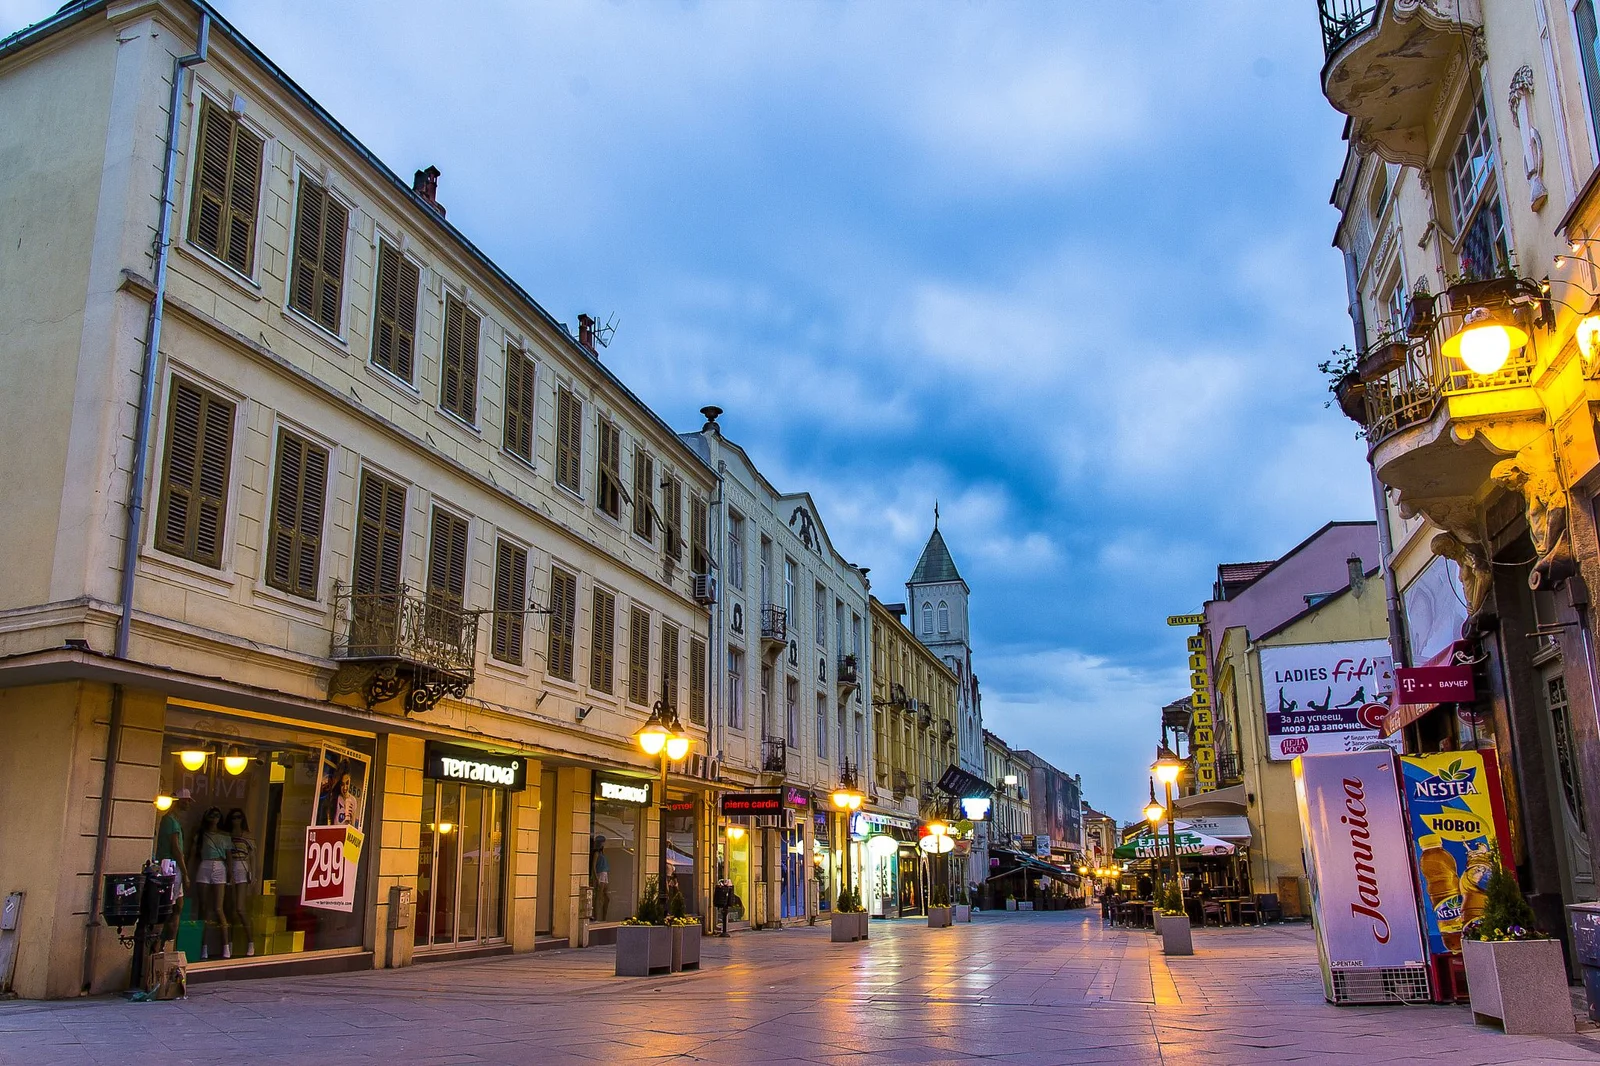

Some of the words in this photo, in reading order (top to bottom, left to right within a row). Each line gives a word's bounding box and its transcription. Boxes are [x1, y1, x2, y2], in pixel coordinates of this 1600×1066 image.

[1170, 616, 1202, 624] HOTEL
[1275, 667, 1328, 683] LADIES
[1439, 680, 1469, 688] ВАУЧЕР
[1280, 715, 1292, 724] За
[1293, 716, 1305, 724] да
[1306, 713, 1344, 724] успееш,
[1281, 725, 1306, 734] мора
[1307, 724, 1320, 733] да
[1283, 745, 1306, 754] РОСА
[1415, 781, 1480, 797] NESTEA
[724, 800, 749, 810] pierre
[751, 800, 779, 809] cardin
[1432, 817, 1481, 834] НОВО!
[307, 840, 344, 889] 299
[1340, 776, 1392, 945] Jamnica
